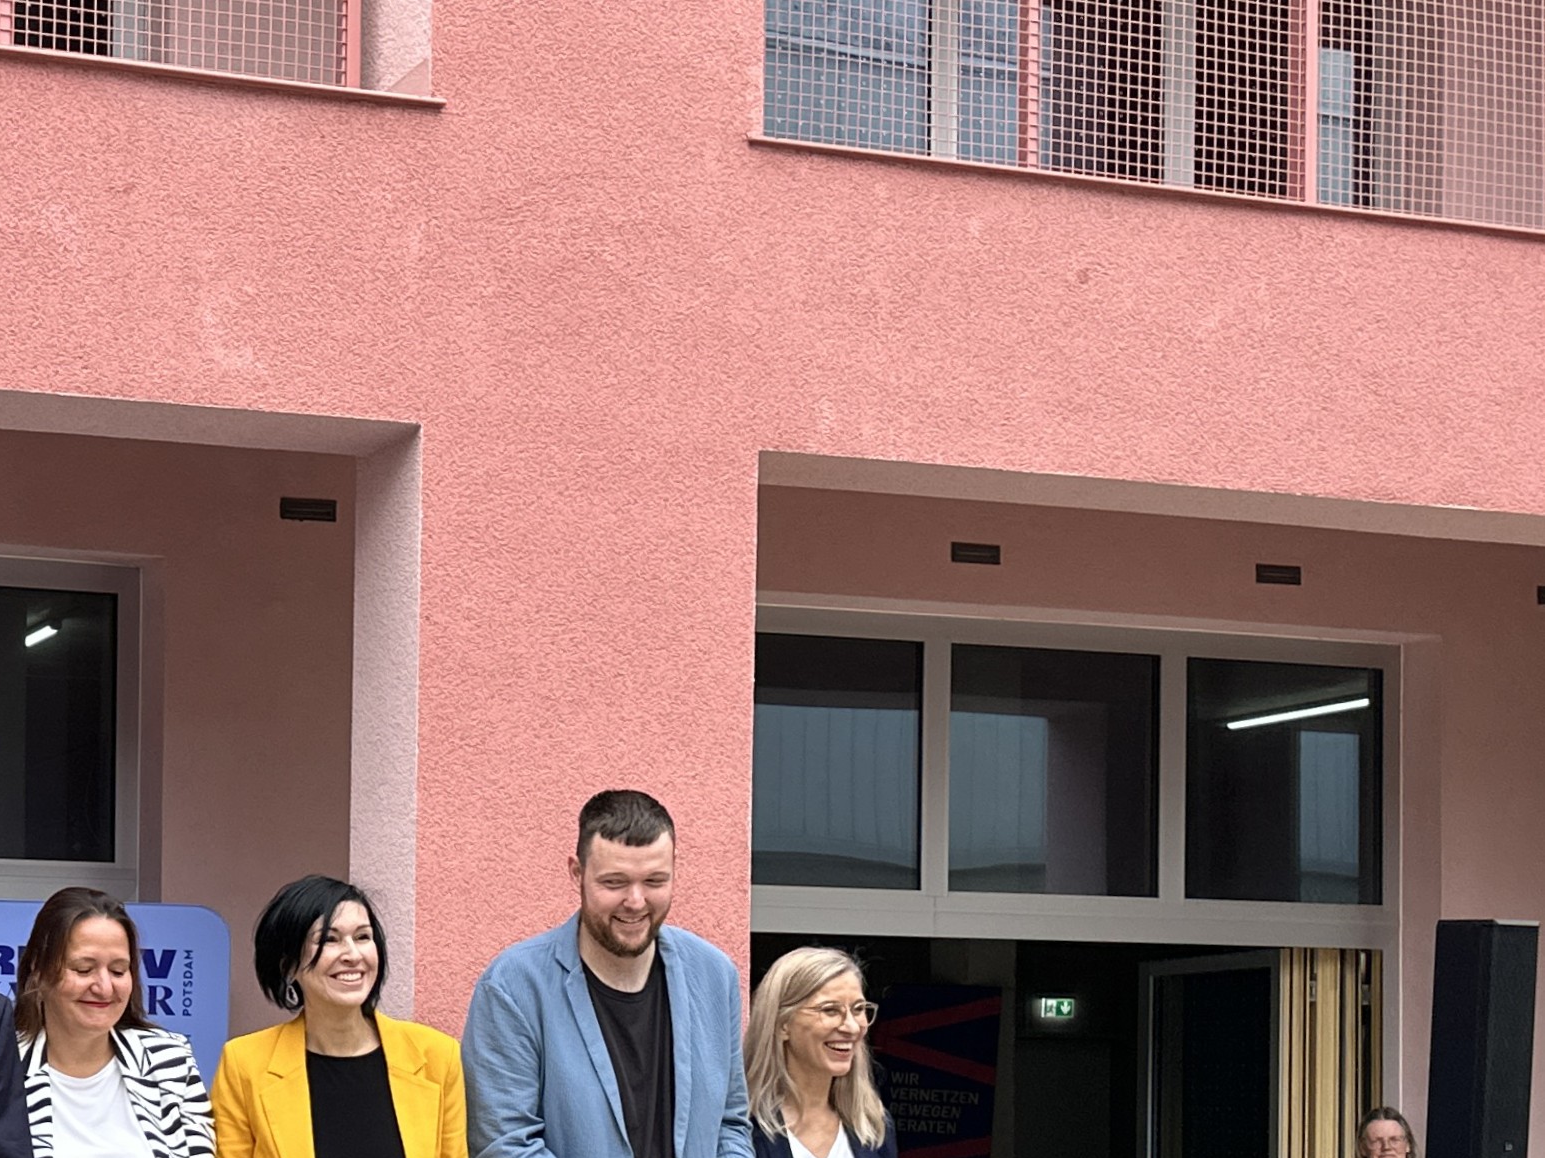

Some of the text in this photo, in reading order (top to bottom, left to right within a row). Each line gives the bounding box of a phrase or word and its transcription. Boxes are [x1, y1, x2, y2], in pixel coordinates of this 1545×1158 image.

[182, 949, 194, 1017] POTSDAM
[890, 1071, 919, 1086] WIR
[889, 1087, 980, 1106] VERNETZEN
